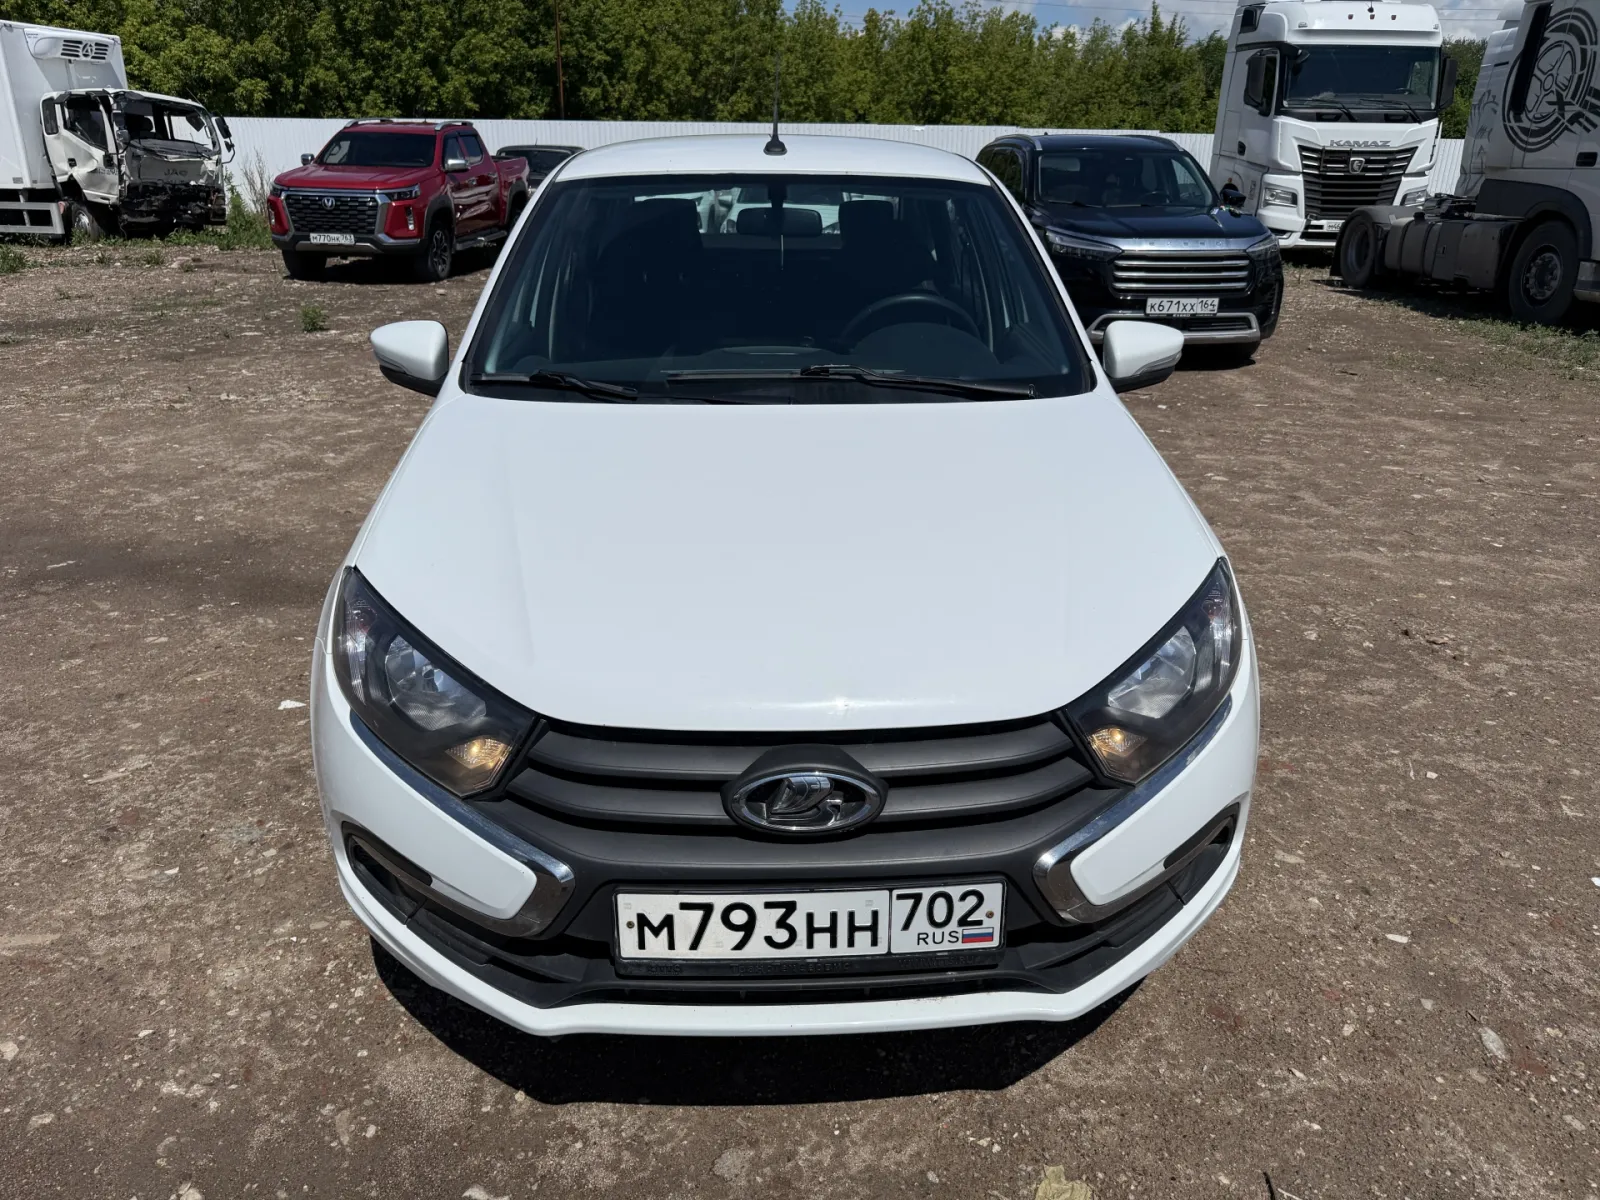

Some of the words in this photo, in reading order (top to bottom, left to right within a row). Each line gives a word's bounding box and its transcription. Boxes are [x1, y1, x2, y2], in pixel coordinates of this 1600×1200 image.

[1329, 140, 1392, 148] KAMAZ
[1149, 300, 1197, 312] K671XX
[1198, 299, 1217, 309] 164
[635, 900, 879, 951] M793HH
[896, 889, 985, 931] 702
[916, 930, 960, 946] RUS
